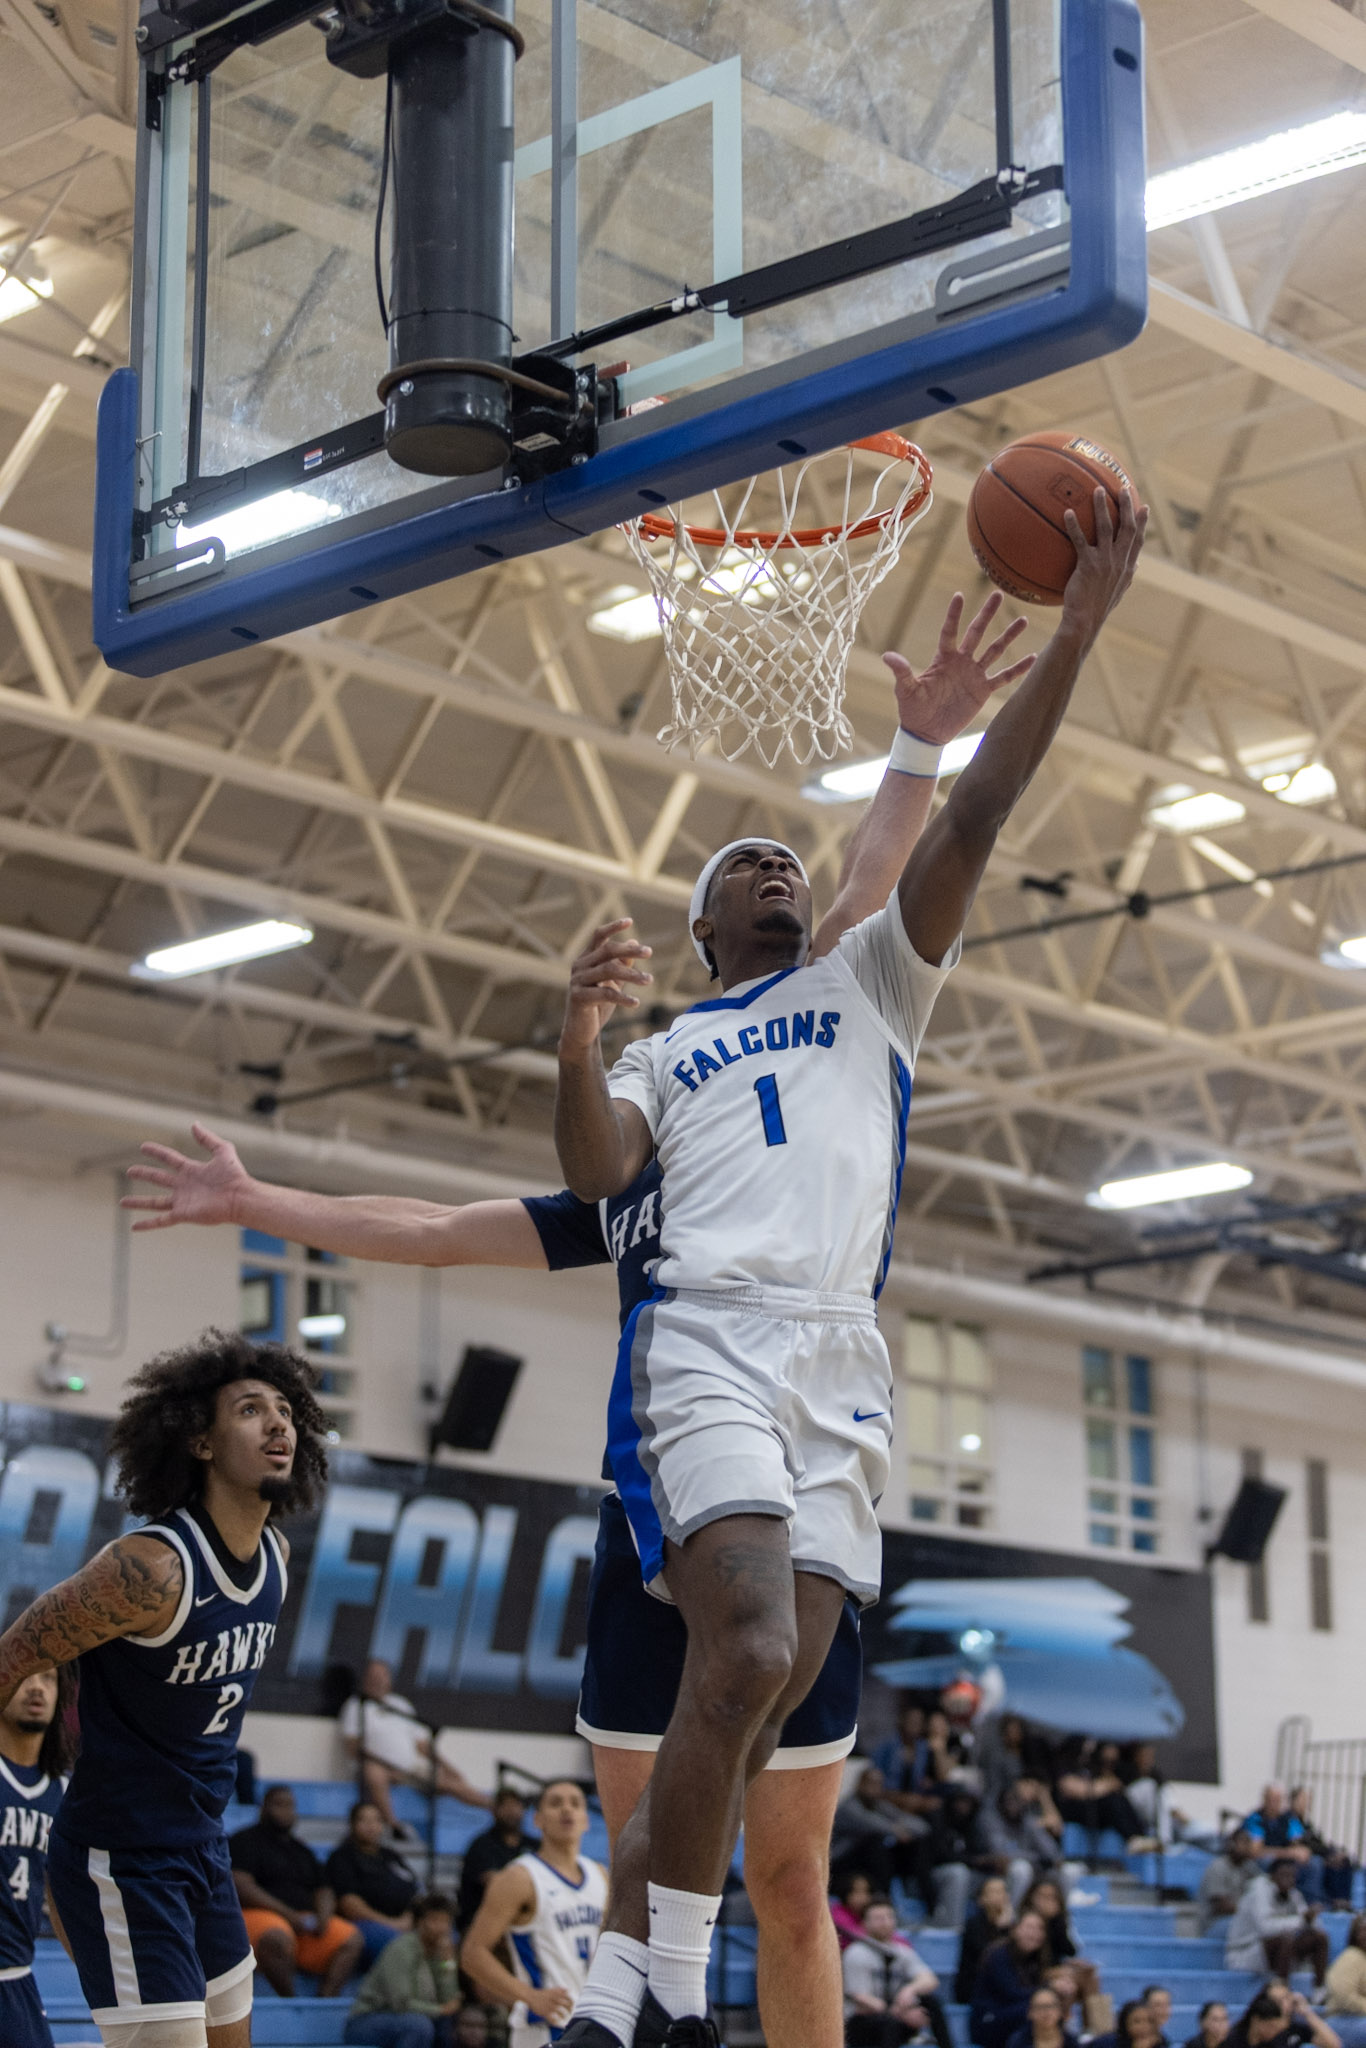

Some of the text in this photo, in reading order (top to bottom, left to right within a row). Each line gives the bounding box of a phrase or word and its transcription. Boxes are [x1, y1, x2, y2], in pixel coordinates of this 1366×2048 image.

[673, 1010, 841, 1092] FALCONS
[754, 1072, 787, 1147] 1
[165, 1622, 276, 1684] HAWK
[202, 1683, 244, 1735] 2
[9, 1855, 29, 1901] 4
